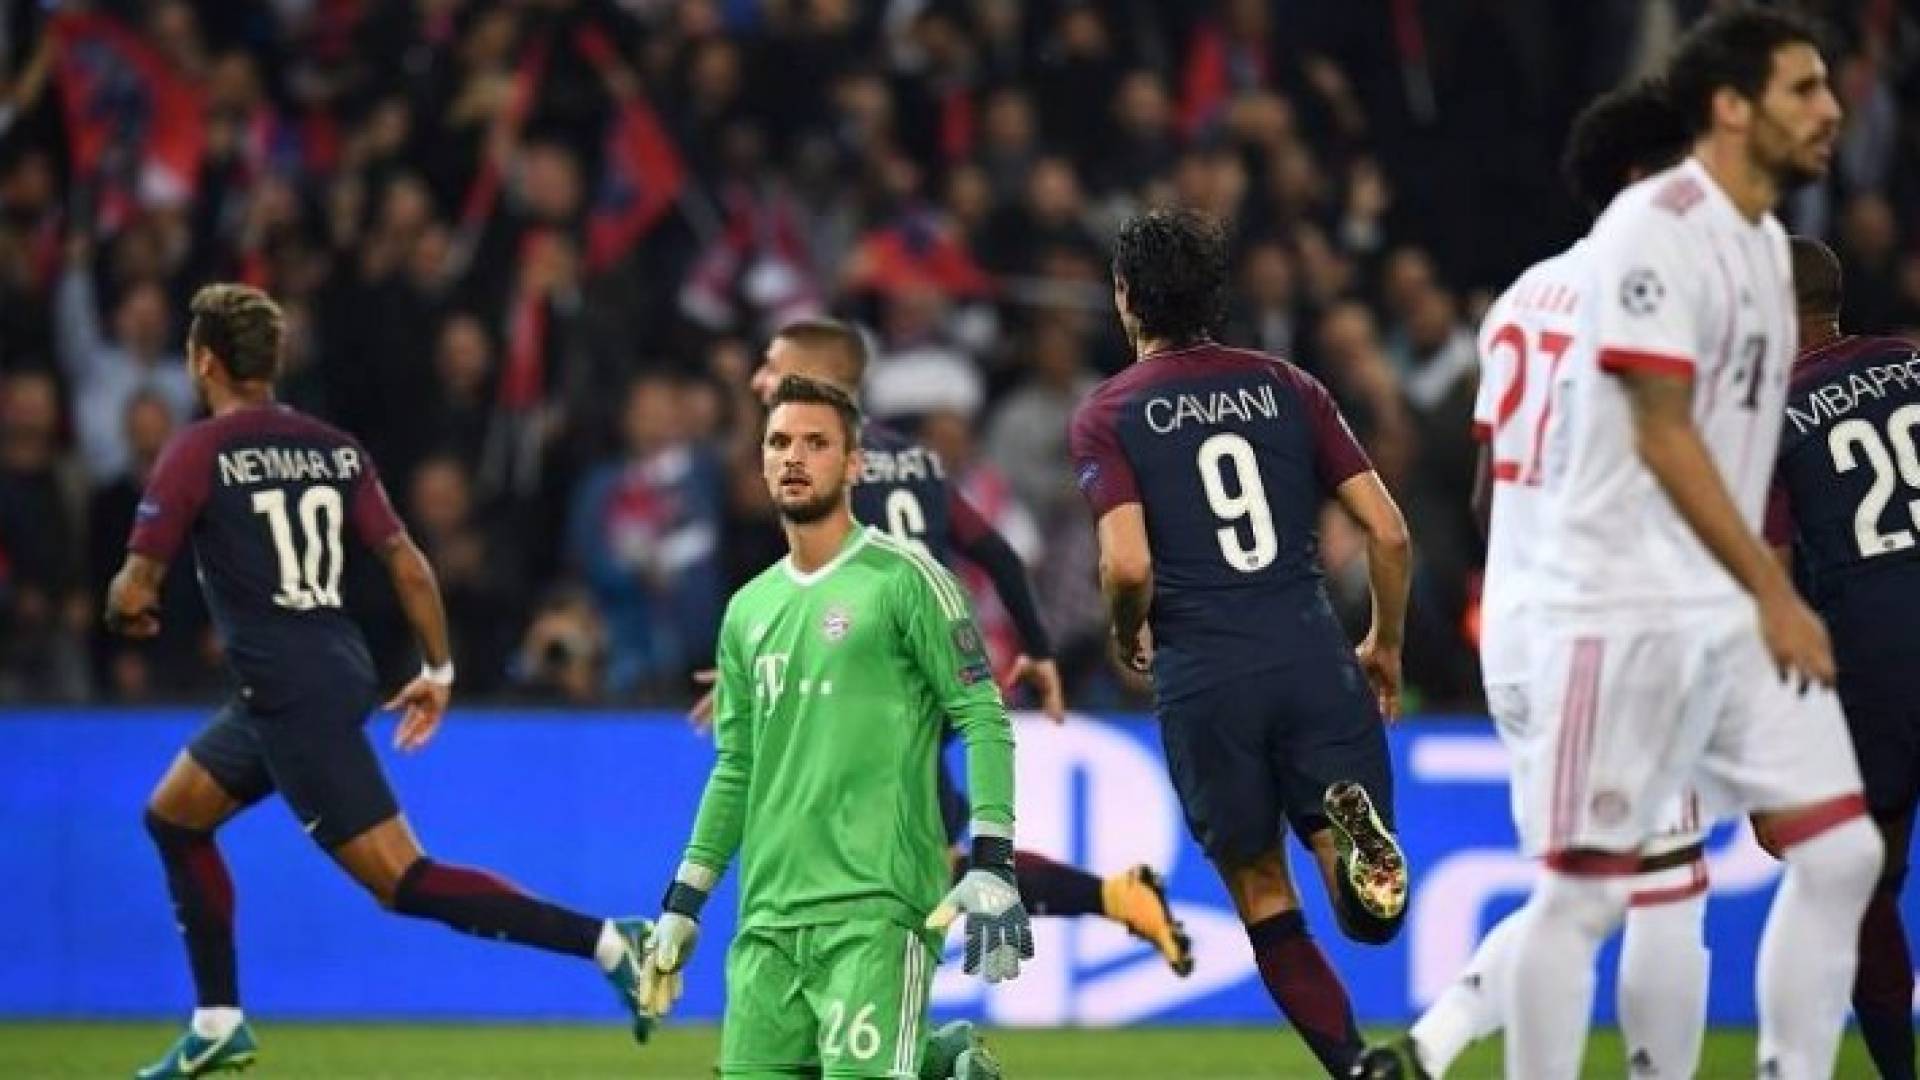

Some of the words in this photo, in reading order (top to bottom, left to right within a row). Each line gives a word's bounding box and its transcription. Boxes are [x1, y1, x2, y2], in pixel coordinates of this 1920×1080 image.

[1145, 385, 1279, 434] CAVANI
[1488, 323, 1574, 486] 27
[218, 446, 333, 486] NEYMAR
[1196, 431, 1279, 573] 9
[251, 486, 344, 611] 10
[819, 1000, 881, 1060] 26
